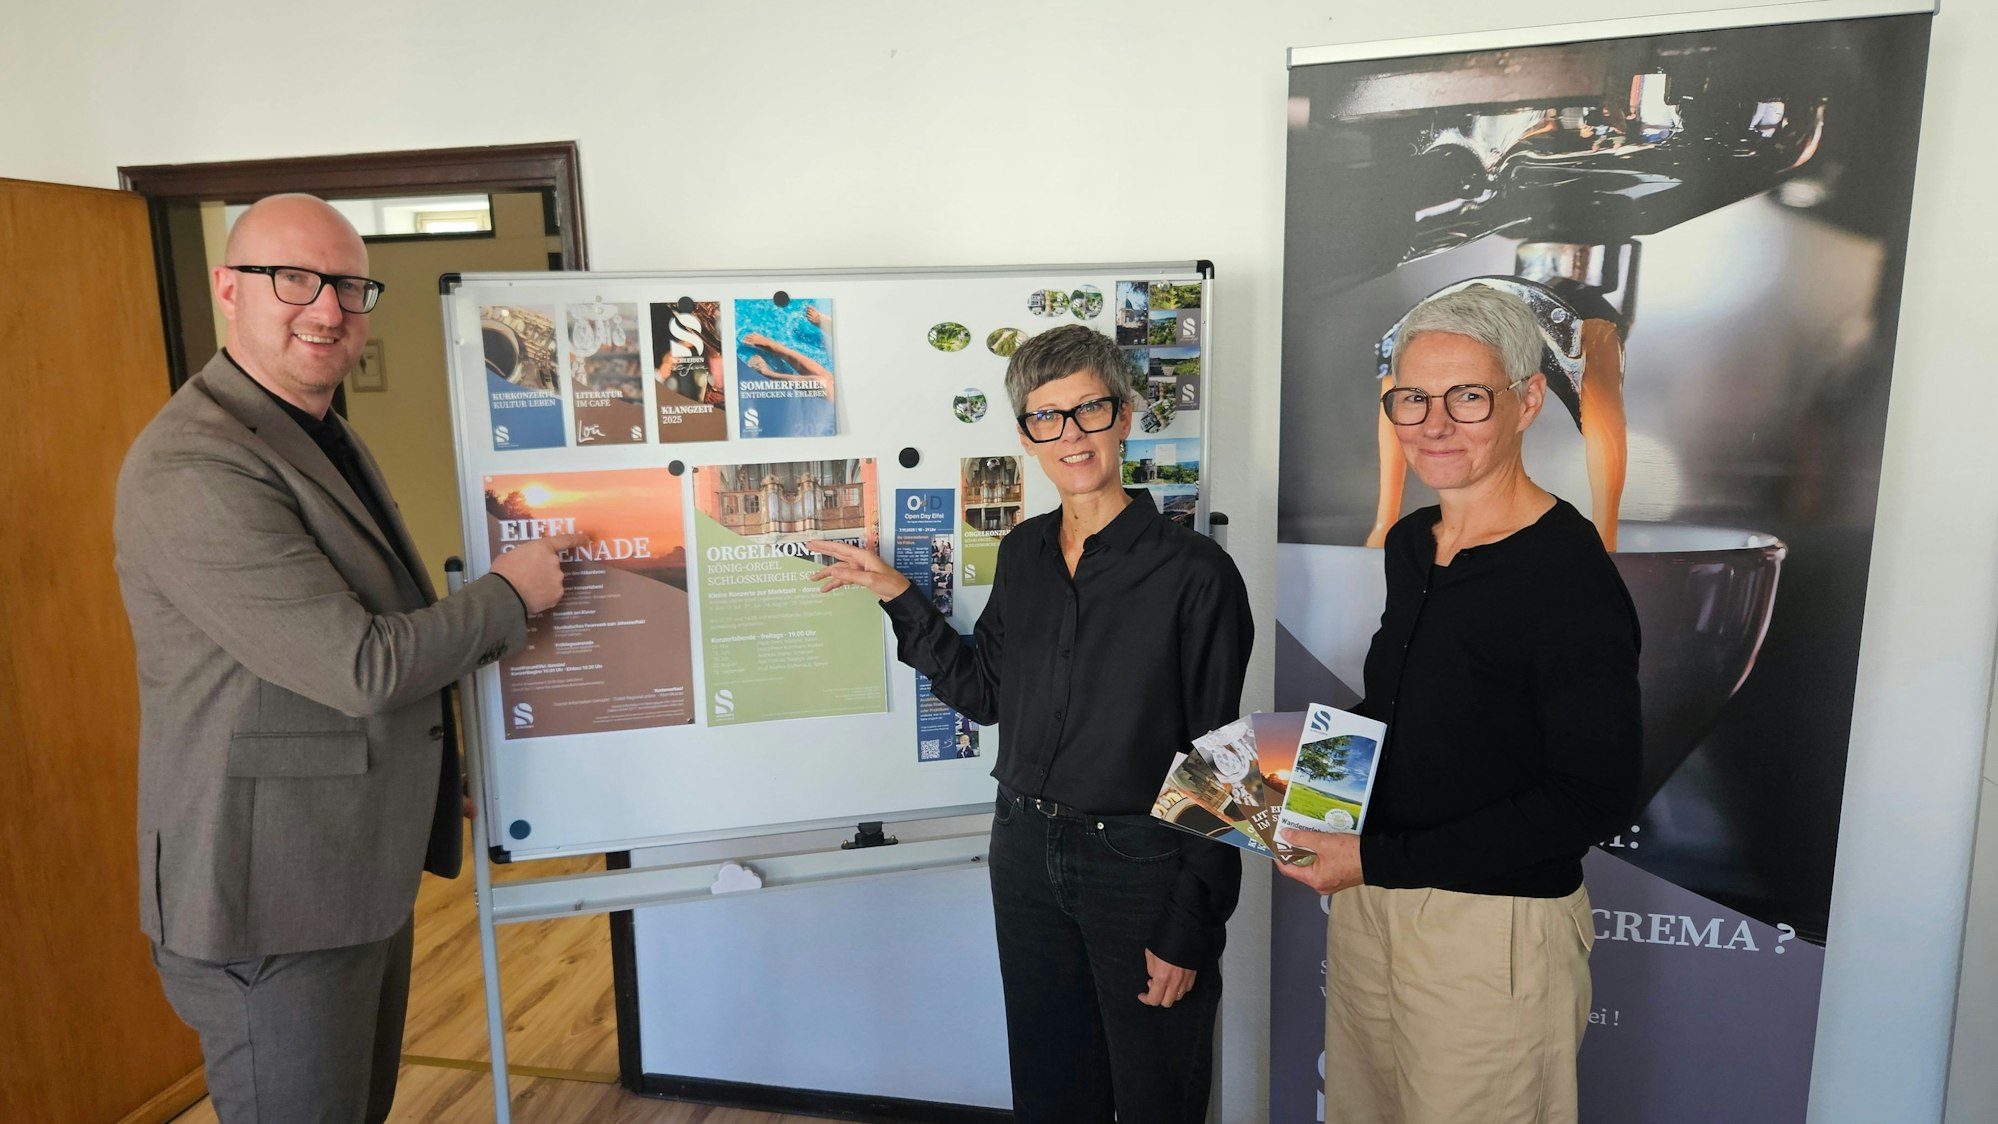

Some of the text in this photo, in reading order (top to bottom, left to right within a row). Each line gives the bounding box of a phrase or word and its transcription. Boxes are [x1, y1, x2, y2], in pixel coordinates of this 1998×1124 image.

[740, 380, 828, 391] SOMMERFERIEN
[492, 390, 555, 401] KURKONZERTE
[575, 390, 623, 400] LITERATUR
[741, 390, 828, 399] ENTDECKEN & ERLEBEN
[493, 399, 556, 410] KULTUR LEBEN
[576, 400, 588, 408] IM
[661, 404, 714, 415] KLANGZEIT
[662, 415, 683, 425] 2025
[707, 560, 783, 575] KÖNIG-ORGEL
[707, 572, 797, 587] SCHLOSSKIRCHE
[729, 590, 756, 598] Konzerte
[767, 587, 797, 595] Marktzeit
[1591, 908, 1760, 952] CREMA
